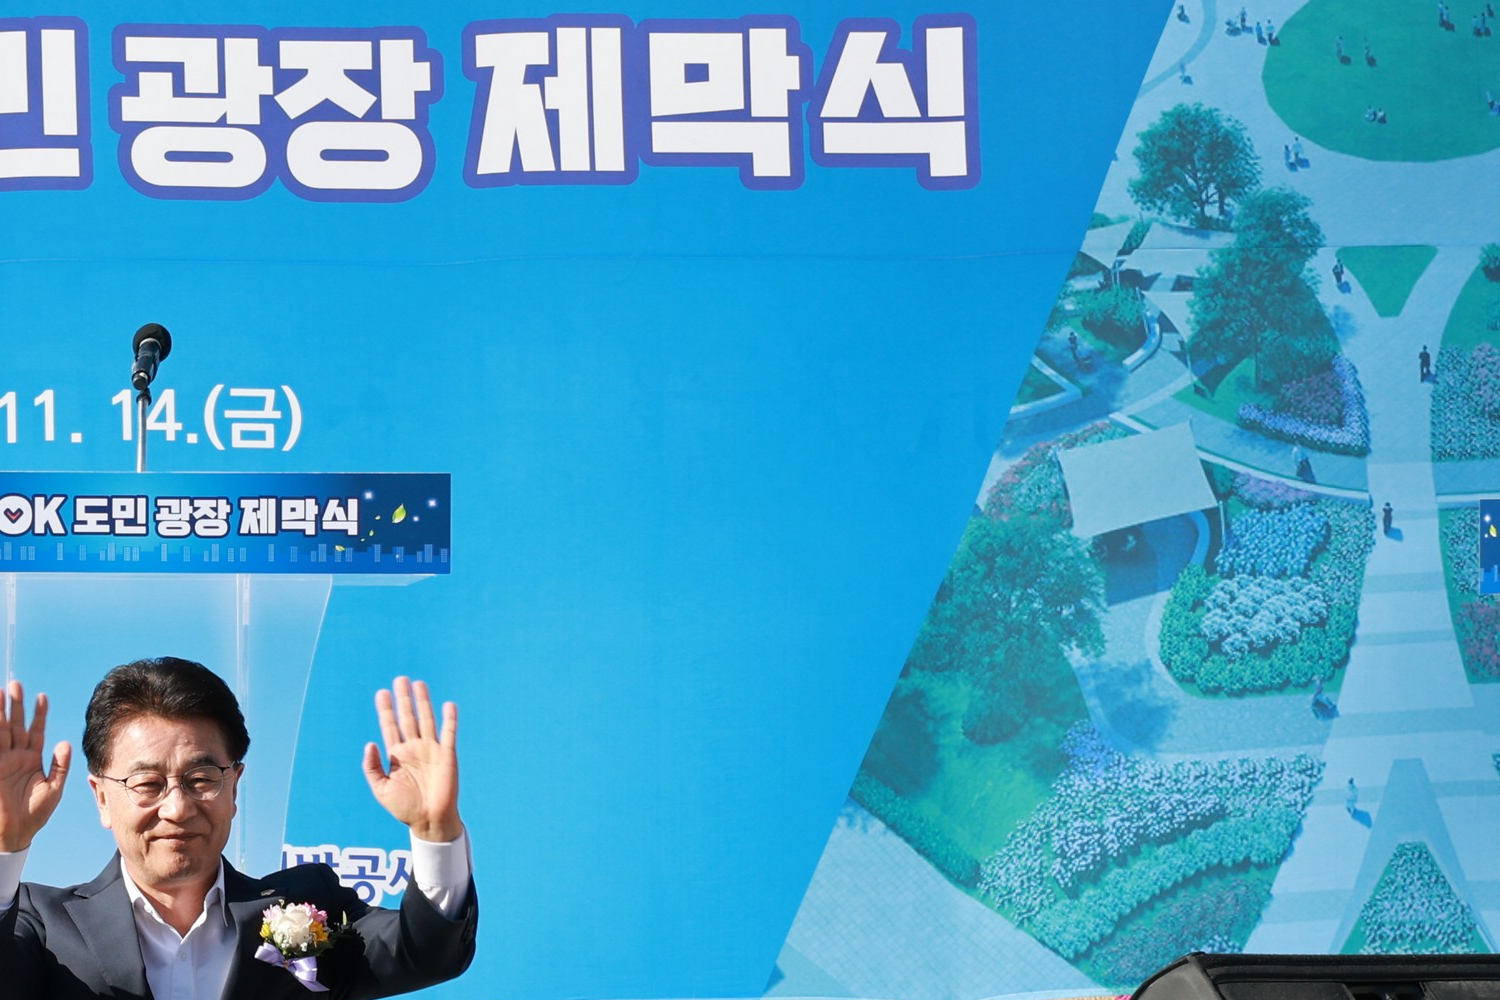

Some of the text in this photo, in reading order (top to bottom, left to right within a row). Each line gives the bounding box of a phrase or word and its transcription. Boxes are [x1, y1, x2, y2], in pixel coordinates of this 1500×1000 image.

[121, 36, 432, 190] 광장
[474, 26, 968, 178] 제막식
[111, 383, 303, 452] 14.(금)
[73, 496, 147, 535] 도민
[155, 498, 231, 537] 광장
[239, 497, 359, 536] 제막식
